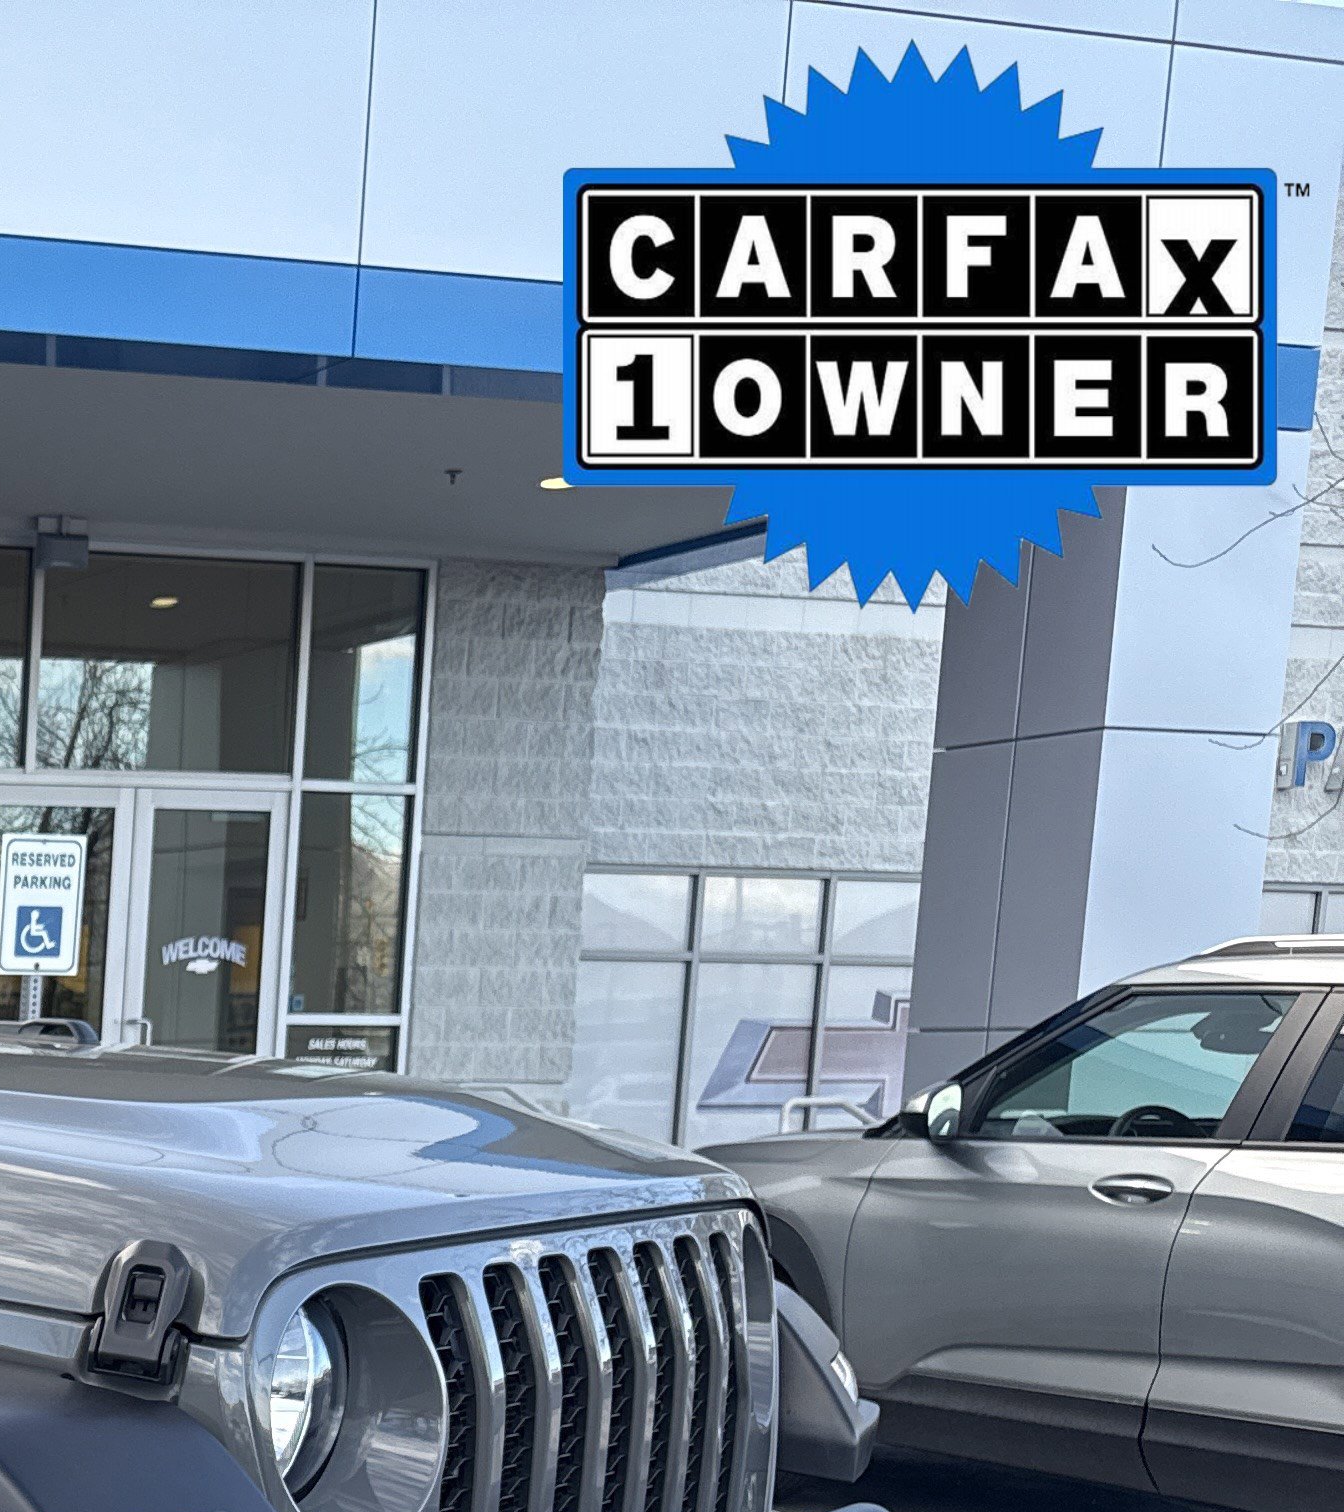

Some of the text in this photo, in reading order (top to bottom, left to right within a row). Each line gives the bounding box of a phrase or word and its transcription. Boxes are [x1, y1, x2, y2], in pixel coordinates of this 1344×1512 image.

[11, 852, 76, 868] RESERVED
[13, 874, 72, 890] PARKING
[161, 936, 246, 967] WELCOME
